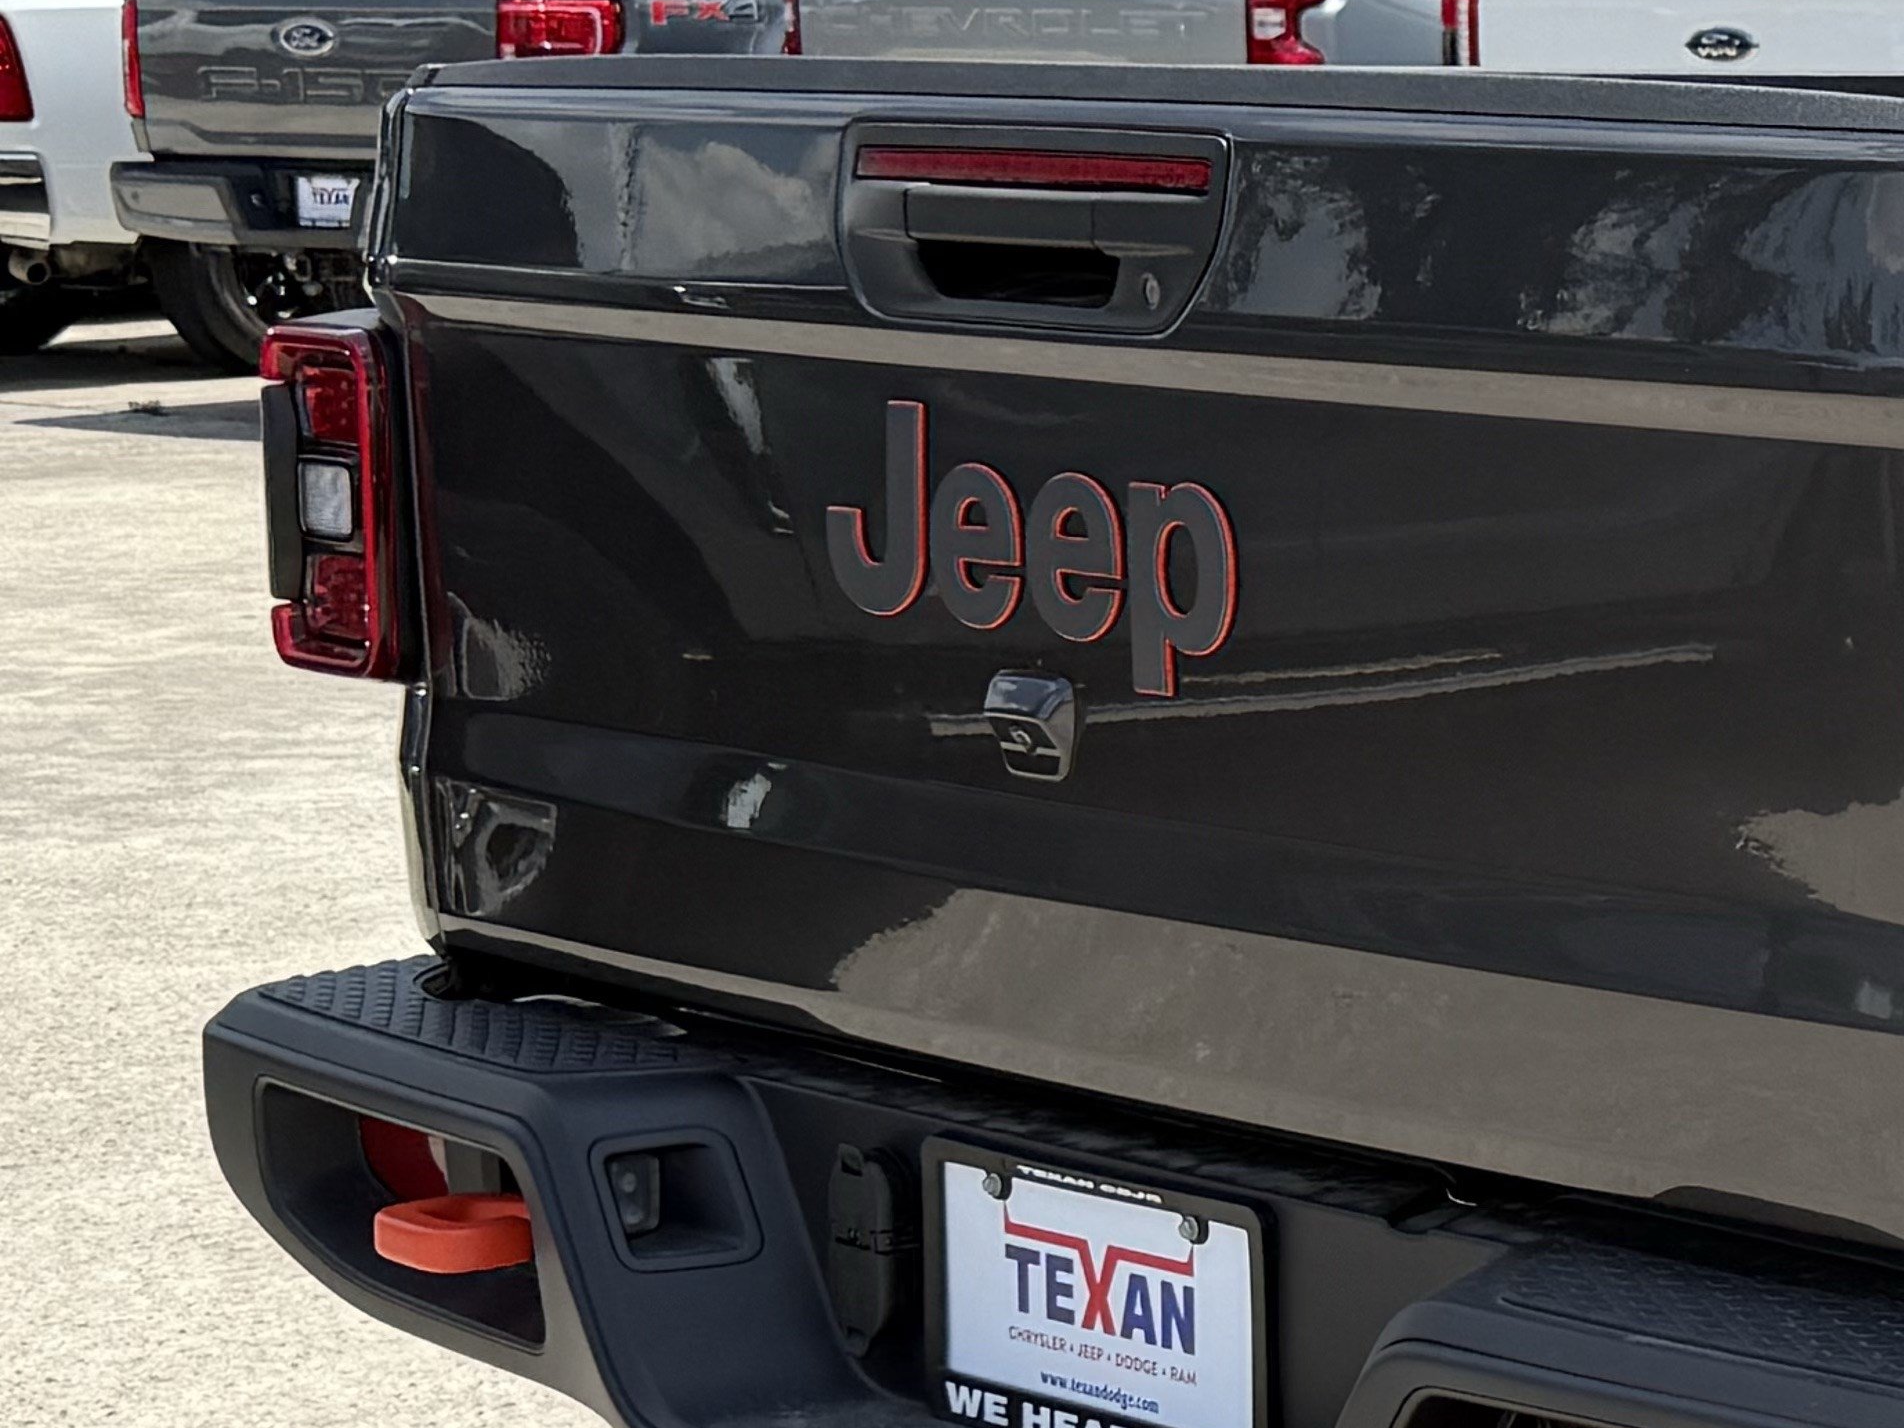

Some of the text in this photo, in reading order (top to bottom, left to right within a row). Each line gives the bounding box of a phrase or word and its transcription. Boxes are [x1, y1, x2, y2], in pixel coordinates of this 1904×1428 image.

[818, 5, 1212, 38] CHEVROLET
[826, 400, 1240, 698] Jeep
[1016, 1164, 1095, 1189] TEXAN
[1004, 1220, 1196, 1356] TEXAN
[1008, 1325, 1197, 1386] CHRYSLER JEEP DODGE RAM
[945, 1380, 1009, 1428] WE
[1040, 1370, 1160, 1414] www.texandodge.com
